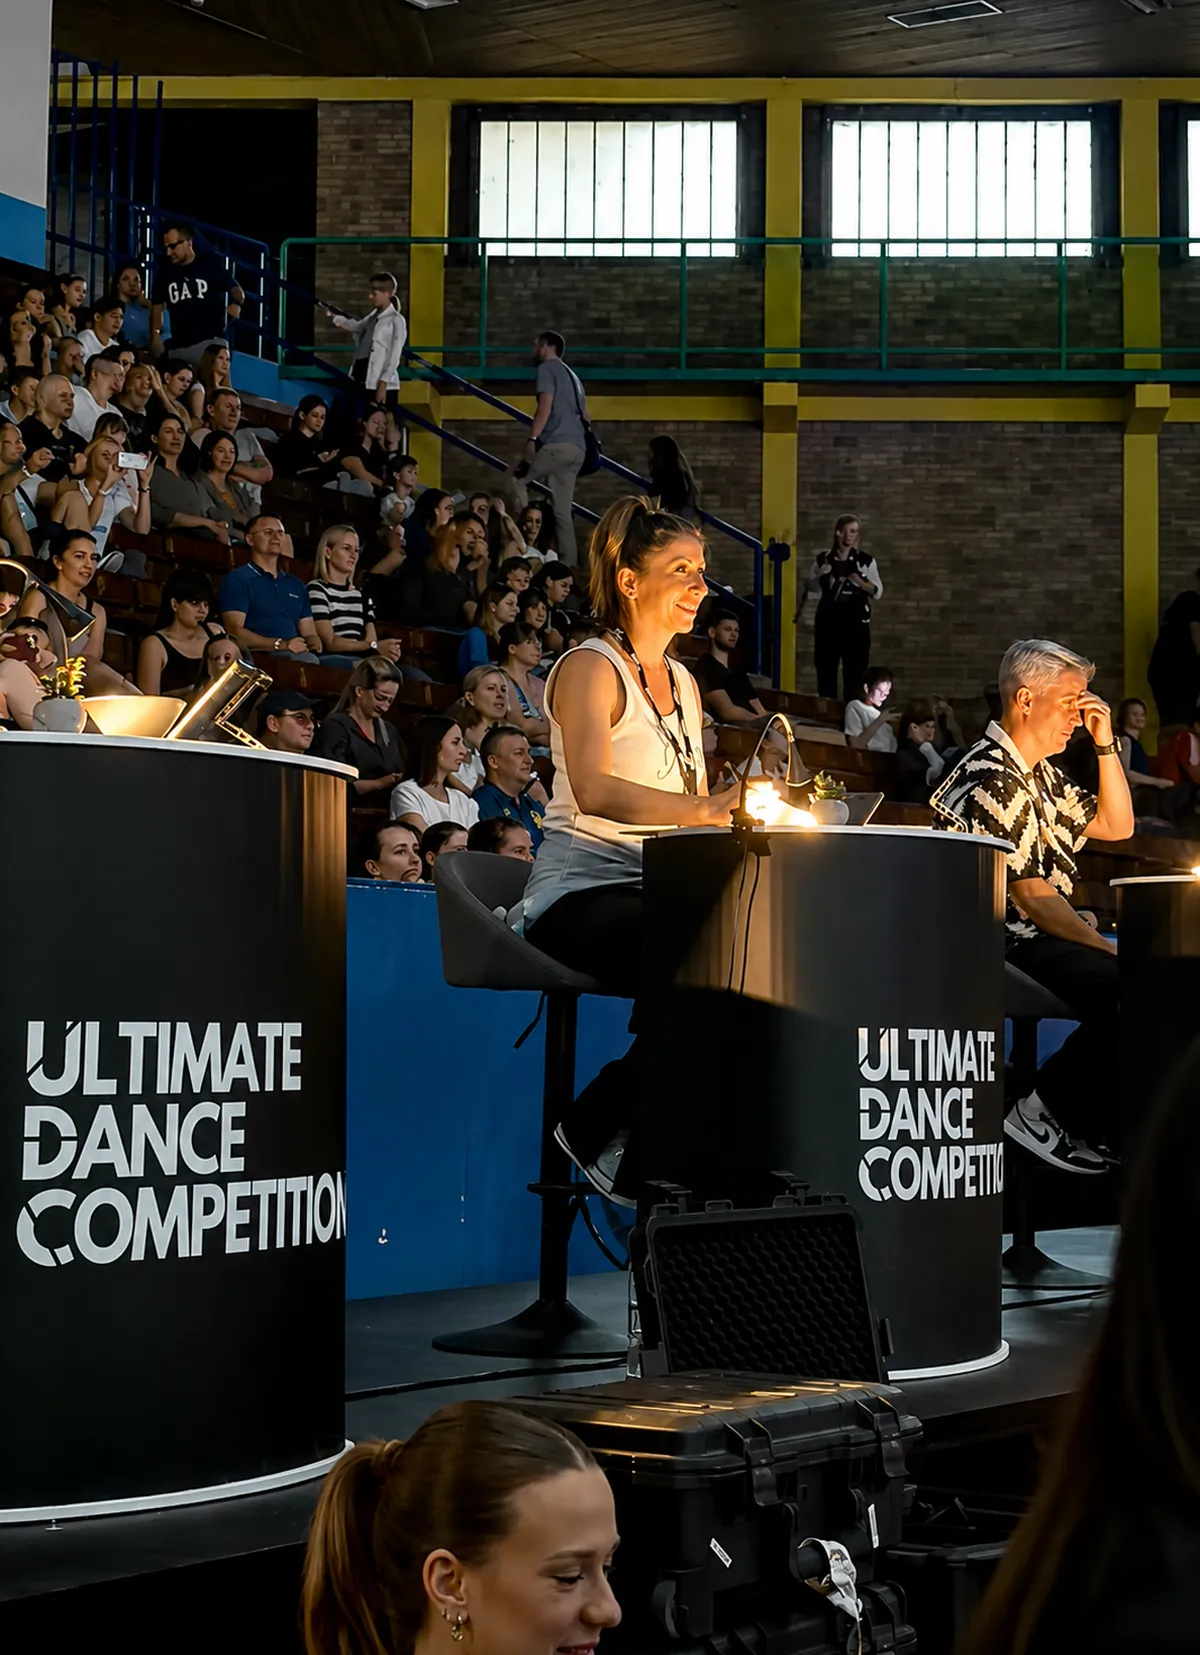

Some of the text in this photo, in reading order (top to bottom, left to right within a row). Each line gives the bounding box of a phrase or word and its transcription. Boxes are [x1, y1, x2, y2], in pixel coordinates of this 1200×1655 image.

[168, 279, 208, 304] GAP
[26, 1021, 302, 1097] ULTIMATE
[858, 1027, 995, 1082] ULTIMATE
[22, 1101, 246, 1181] DANCE
[859, 1087, 973, 1140] DANCE
